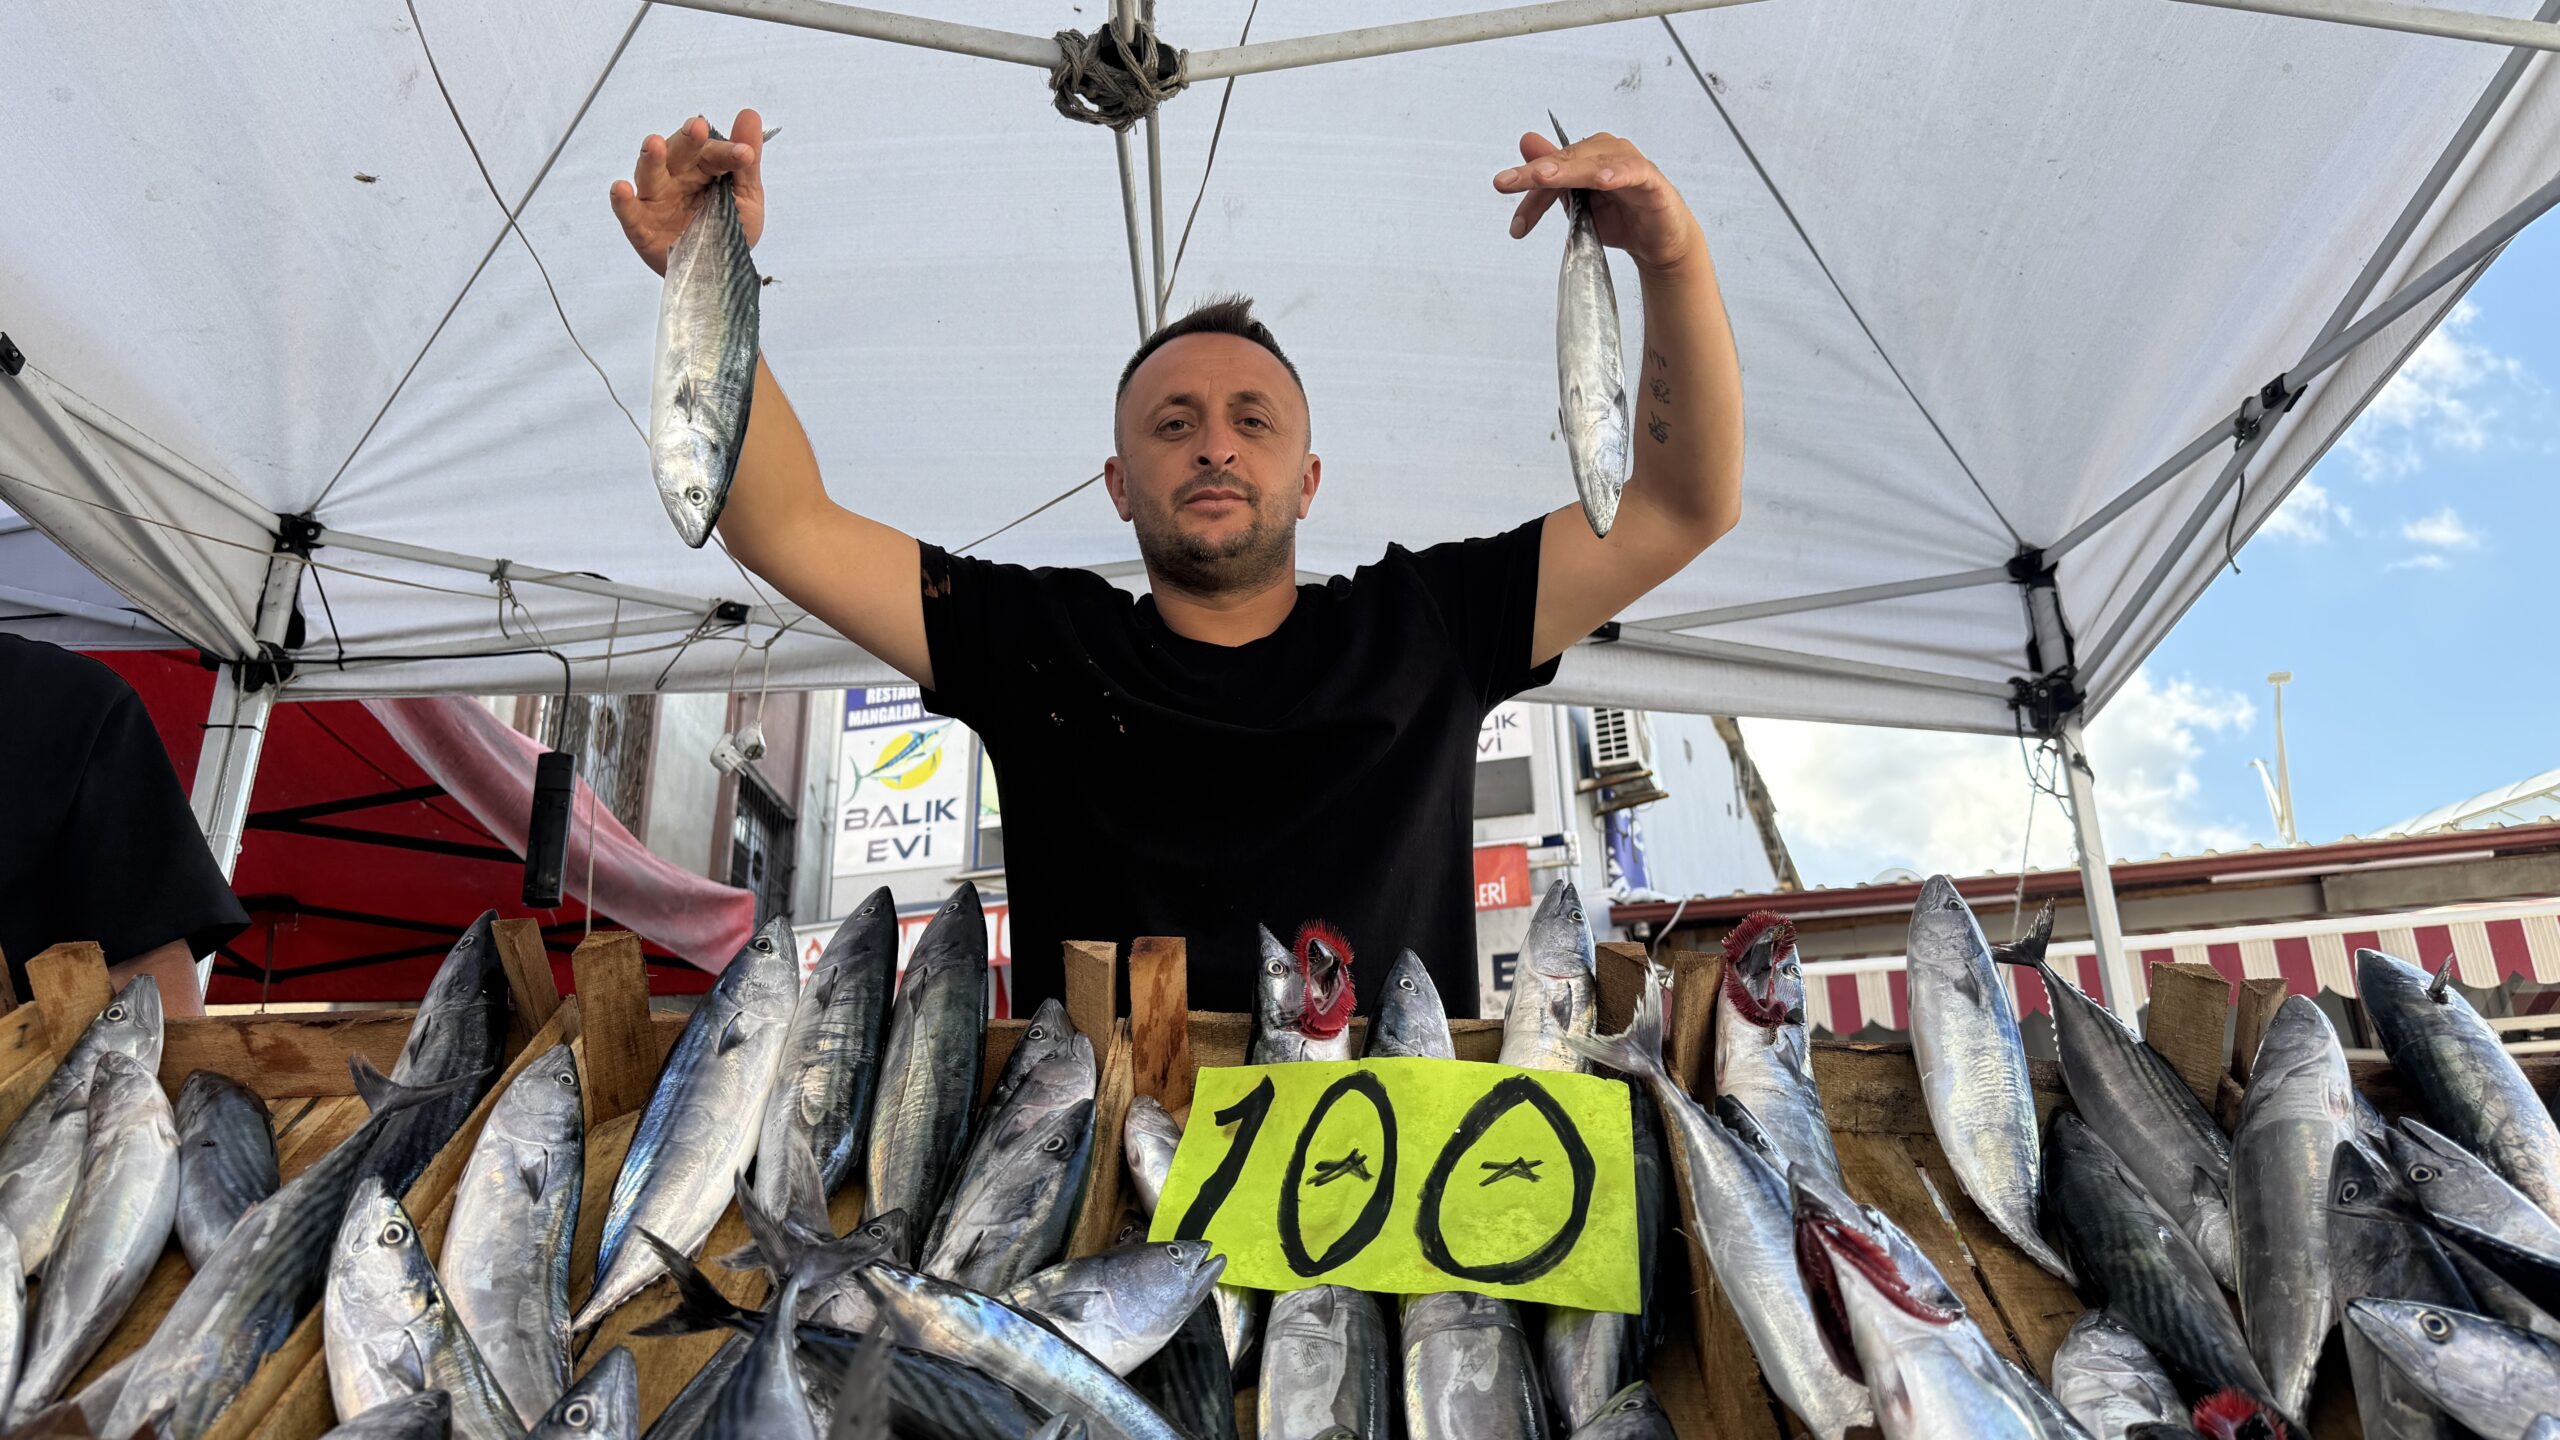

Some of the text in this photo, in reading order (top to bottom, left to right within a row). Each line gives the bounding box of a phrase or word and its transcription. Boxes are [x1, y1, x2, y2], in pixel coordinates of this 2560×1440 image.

[847, 702, 921, 728] MANGALDA
[844, 797, 959, 832] BALIK
[866, 827, 931, 864] EVİ
[1475, 876, 1507, 907] ERİ
[1174, 1069, 1596, 1285] 100
